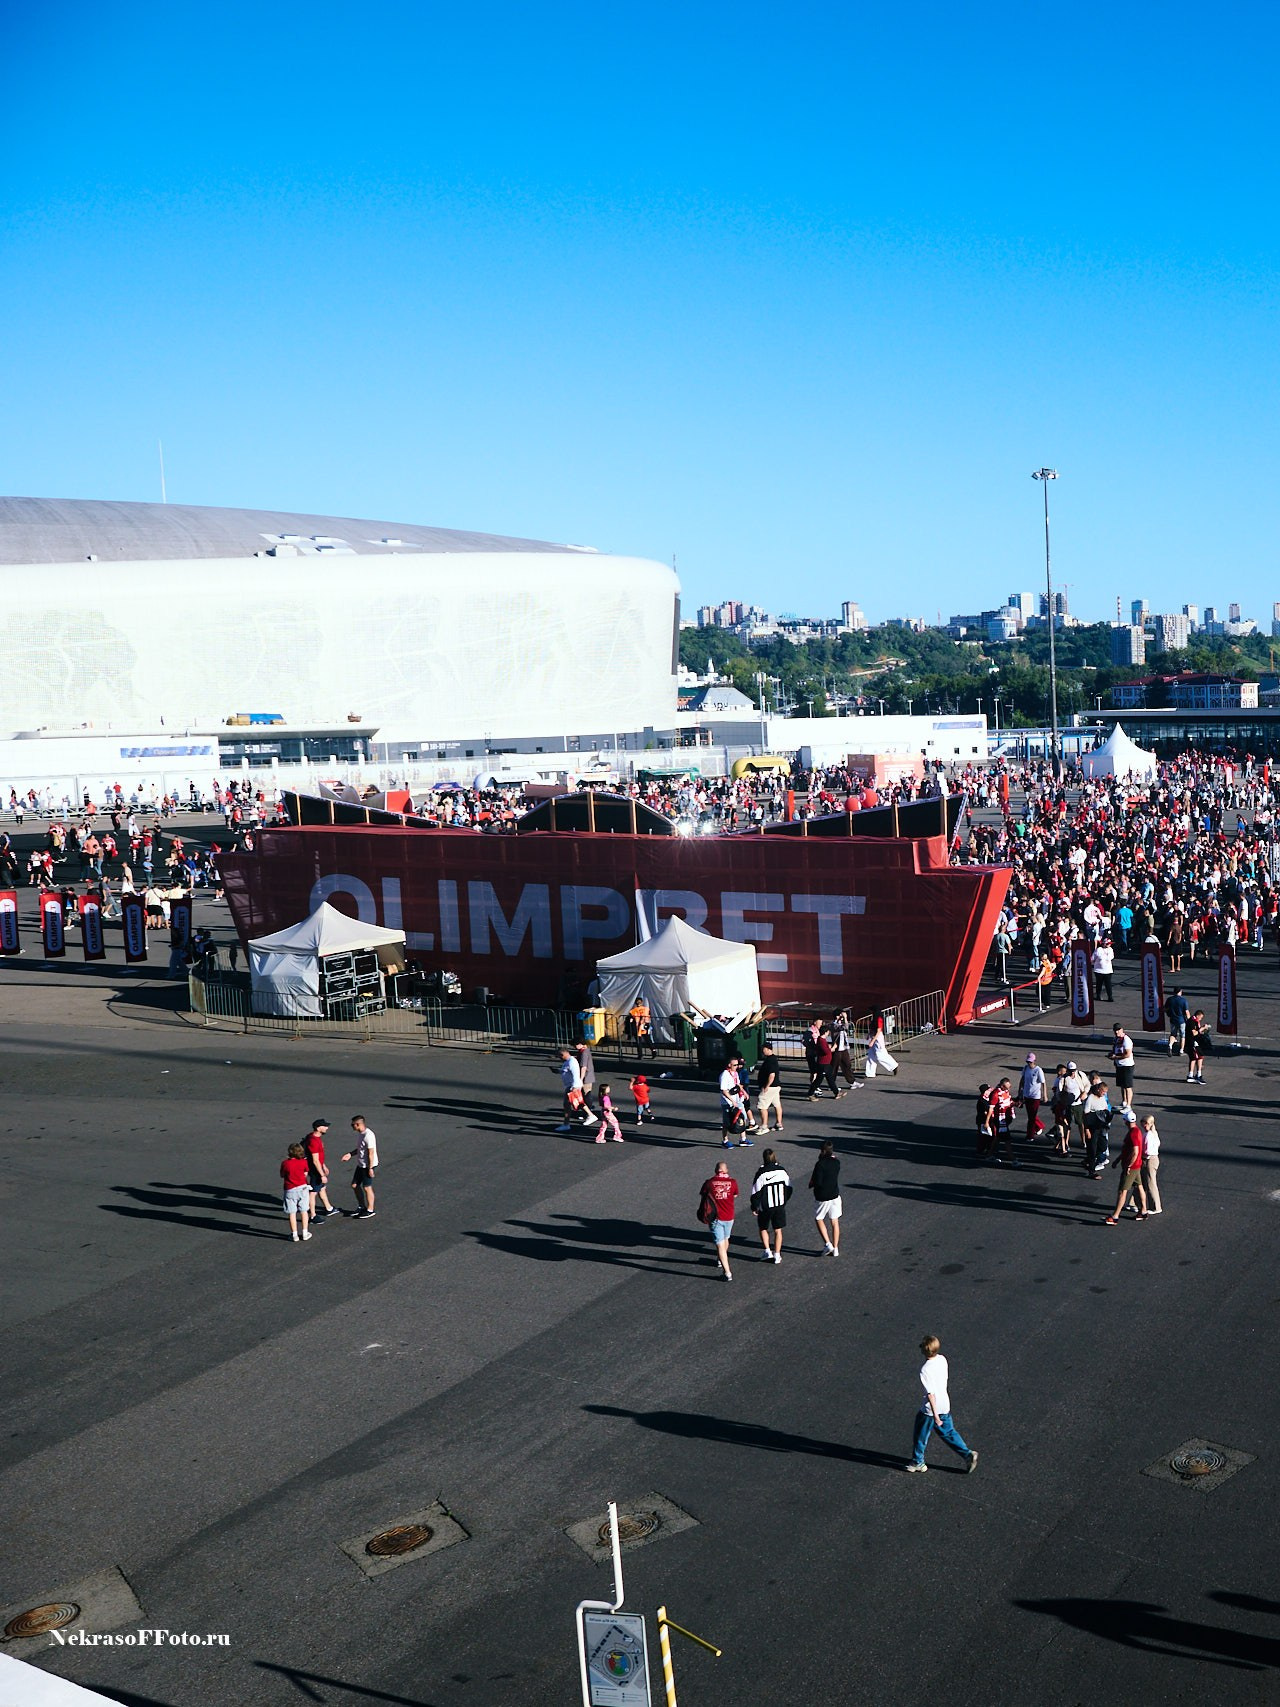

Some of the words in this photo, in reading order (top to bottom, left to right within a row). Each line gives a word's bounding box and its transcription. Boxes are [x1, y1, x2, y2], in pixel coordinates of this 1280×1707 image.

[130, 908, 139, 951] OLIMPBET
[310, 873, 866, 976] OLIMPBET
[1077, 956, 1085, 1013] OLIMPBET
[1147, 959, 1155, 1018] OLIMPBET
